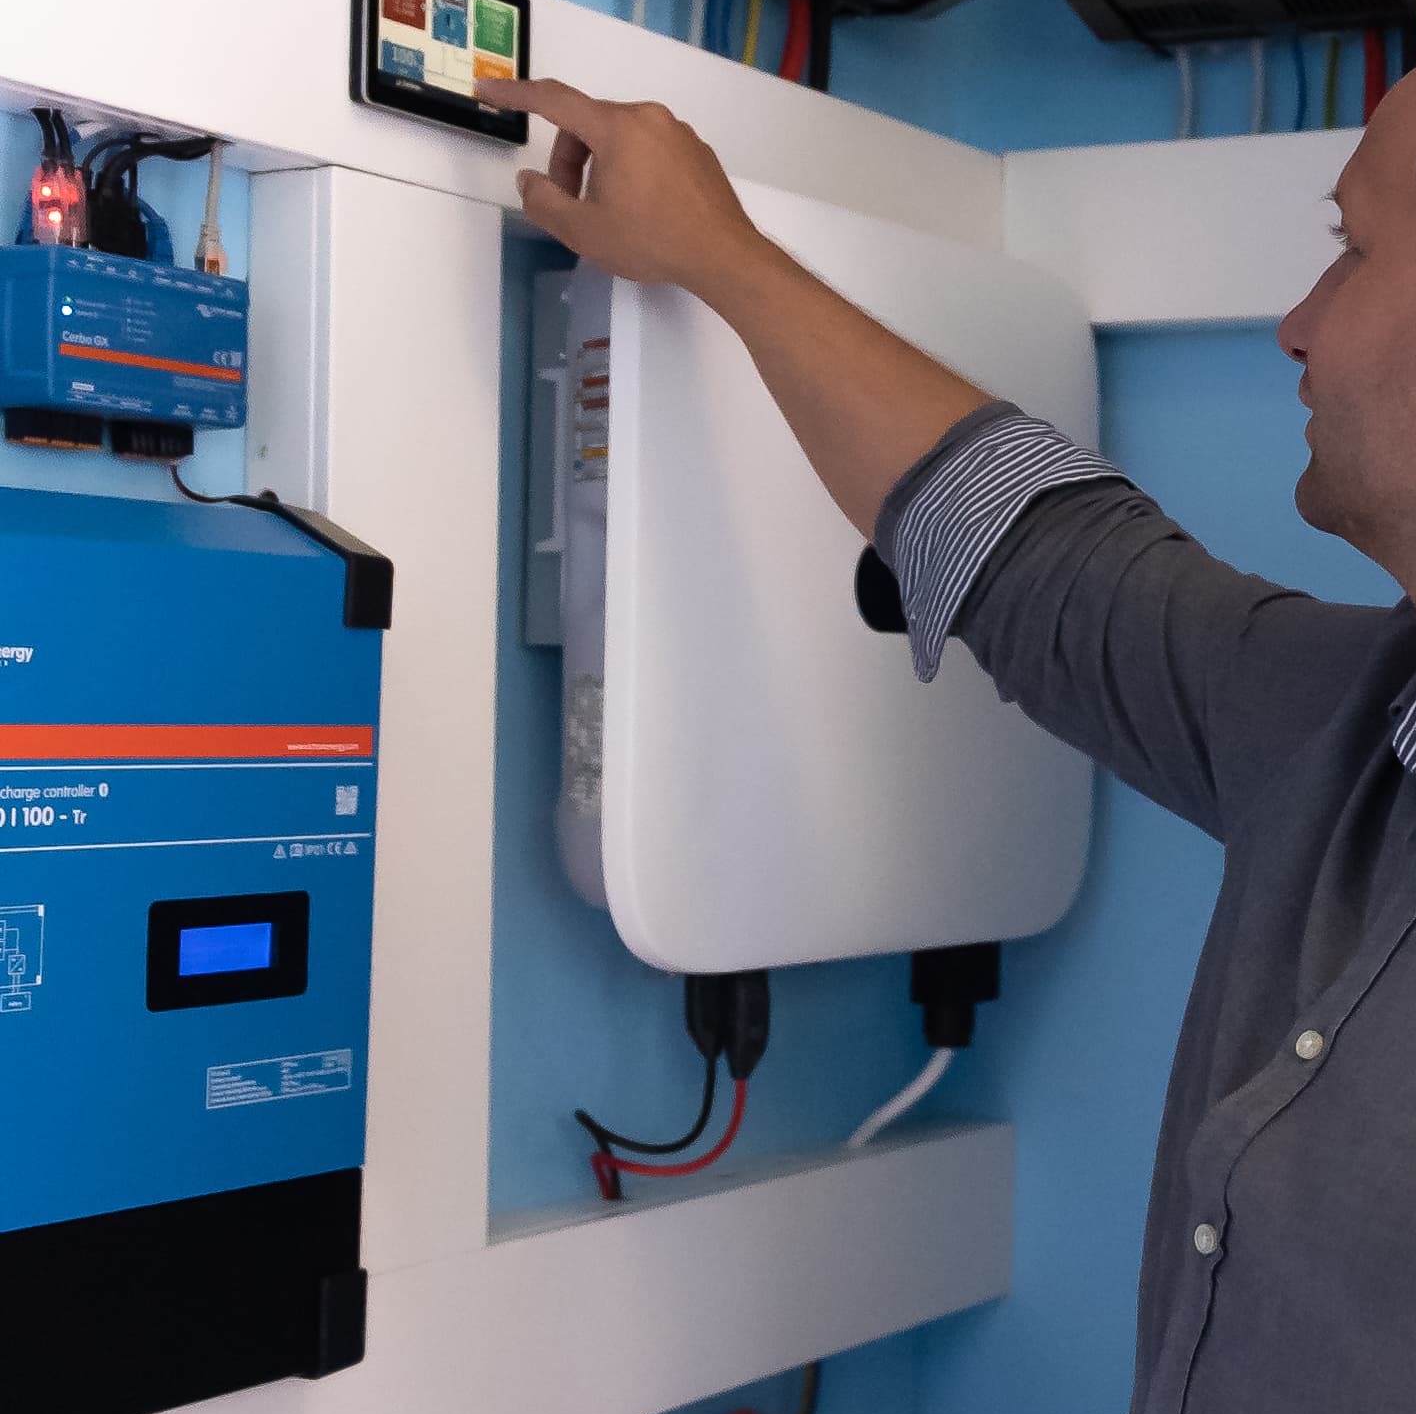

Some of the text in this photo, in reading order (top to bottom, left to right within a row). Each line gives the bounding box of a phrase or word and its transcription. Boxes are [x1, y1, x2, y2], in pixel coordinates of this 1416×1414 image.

[94, 335, 110, 347] GX
[0, 646, 34, 663] ergy
[0, 783, 96, 802] charge controller
[22, 806, 55, 827] 100
[72, 809, 87, 825] Tr
